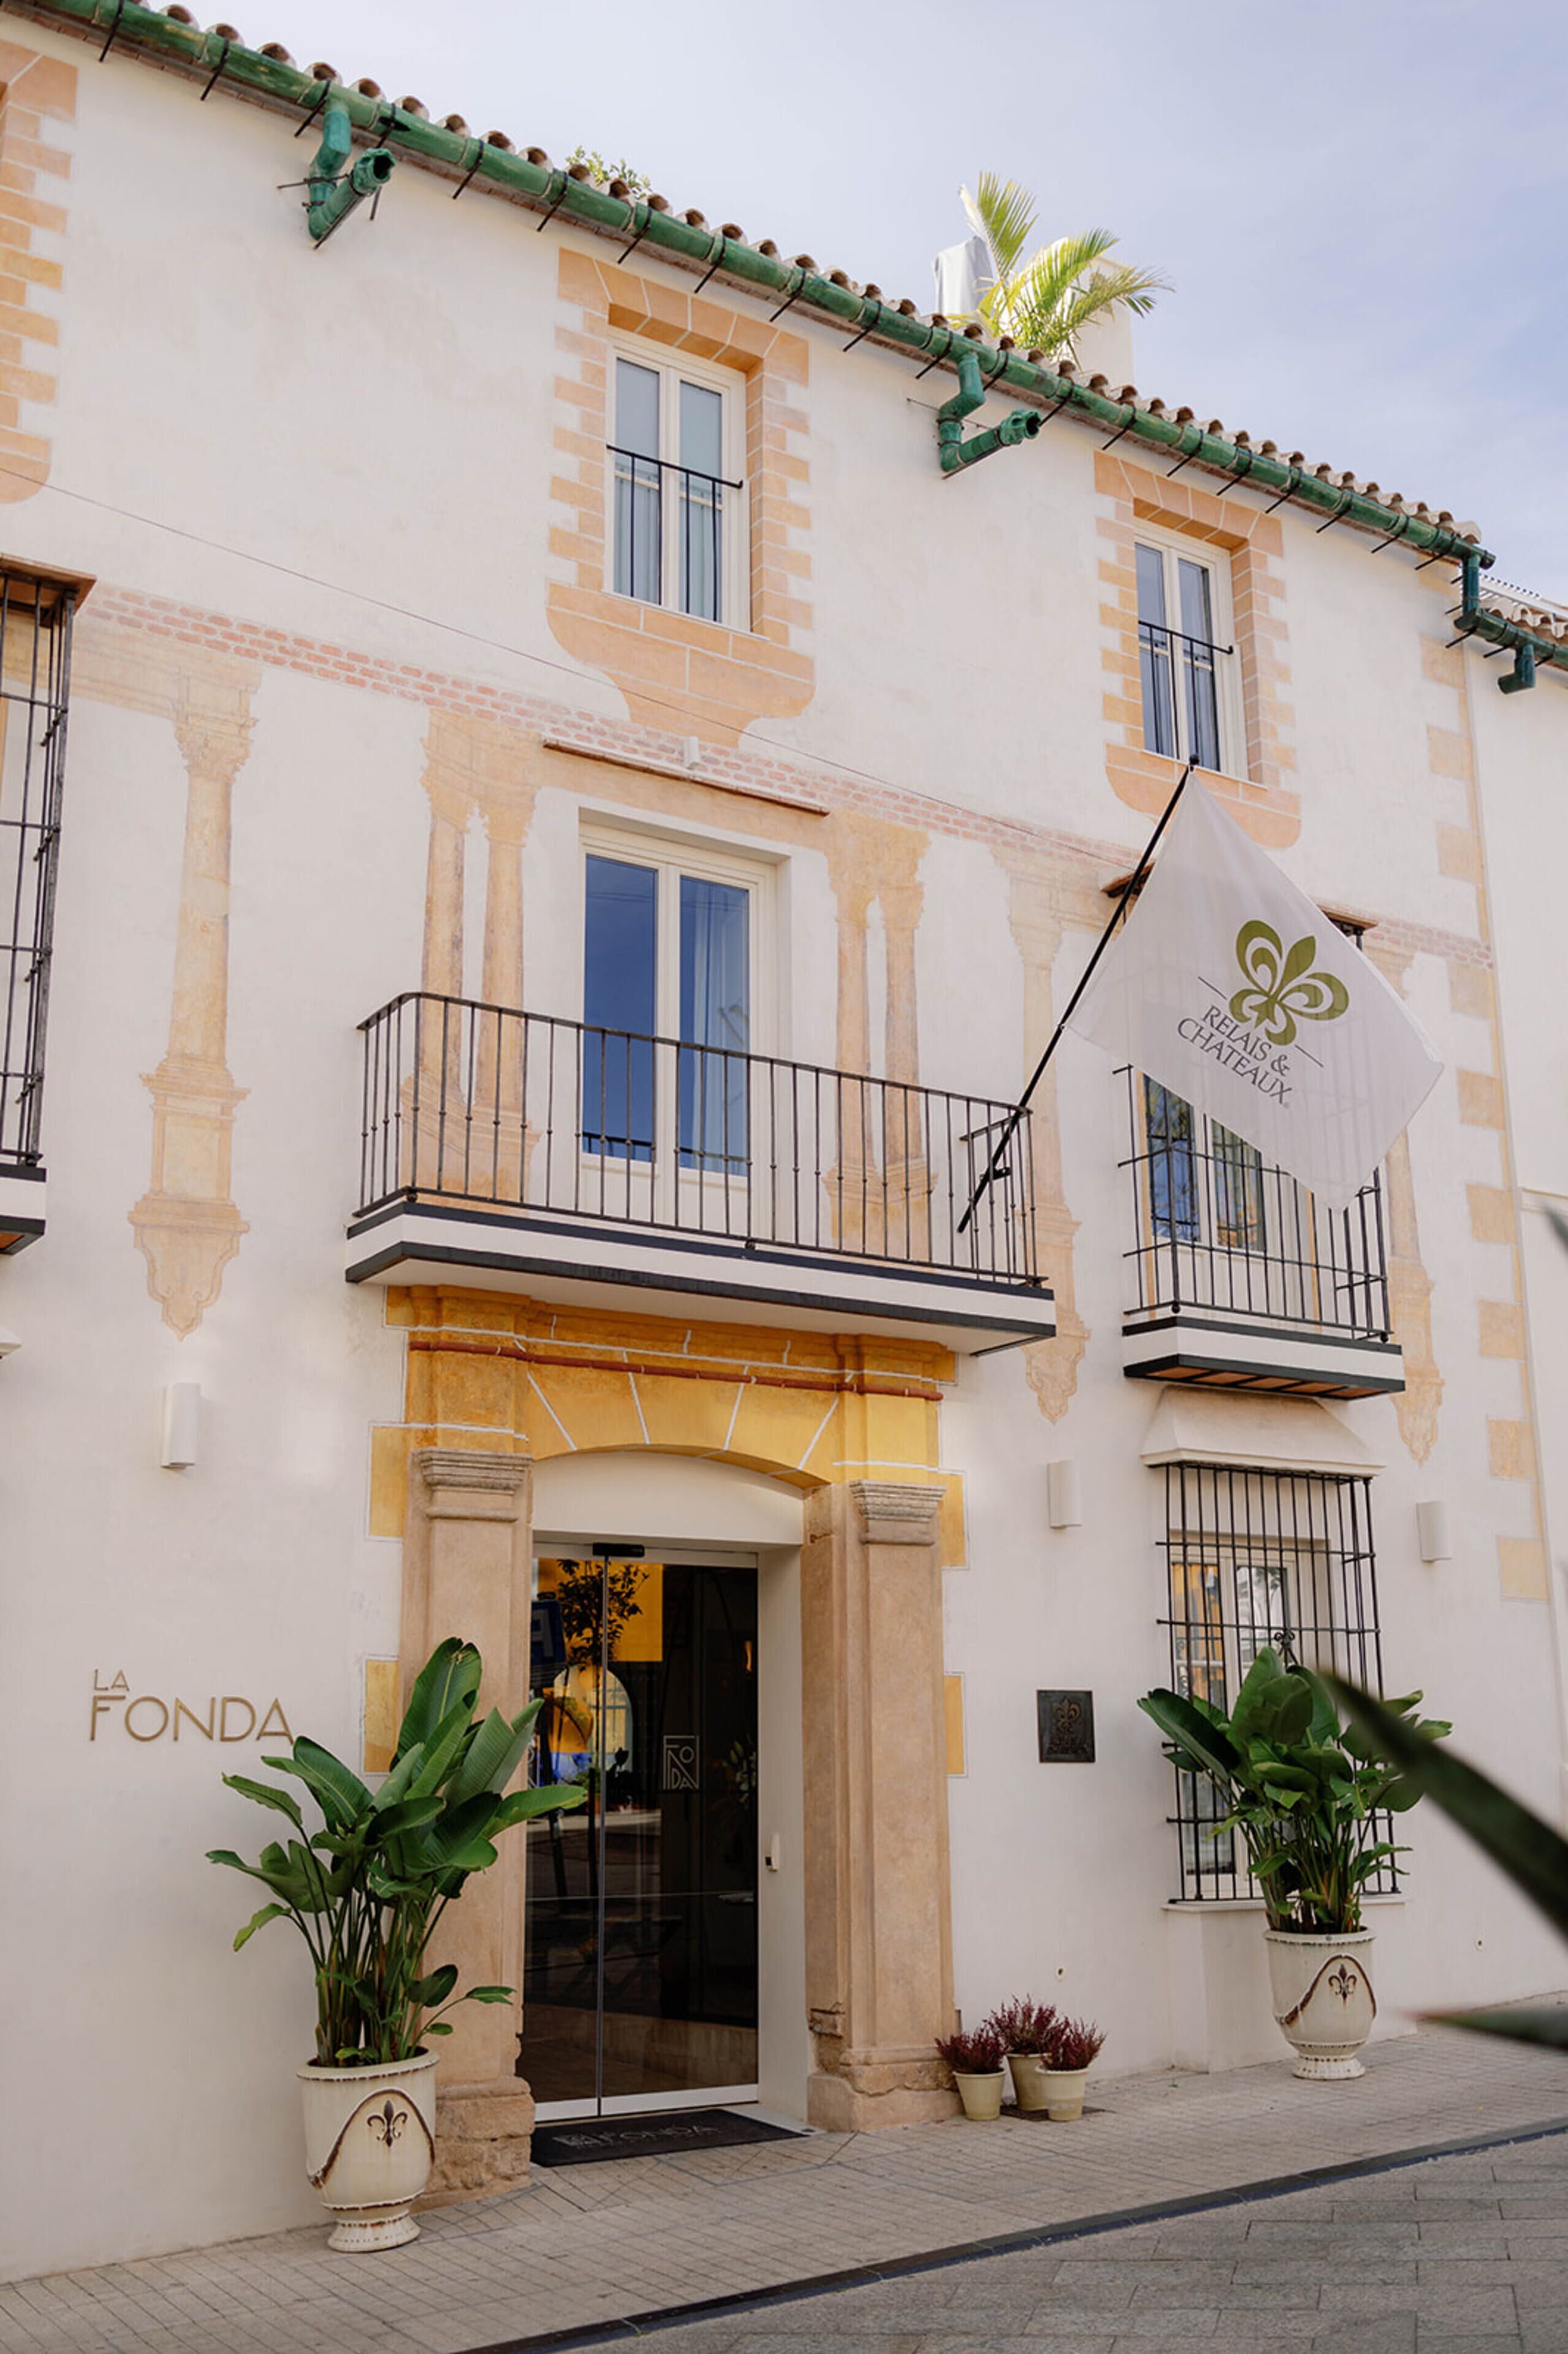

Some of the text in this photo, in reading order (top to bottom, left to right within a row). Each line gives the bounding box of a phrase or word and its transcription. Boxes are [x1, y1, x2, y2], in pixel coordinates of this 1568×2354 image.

[1178, 1018, 1292, 1104] CHATEAUX
[1202, 1005, 1290, 1076] RELAIS &
[94, 1669, 130, 1691] LA
[90, 1695, 294, 1745] FONDA
